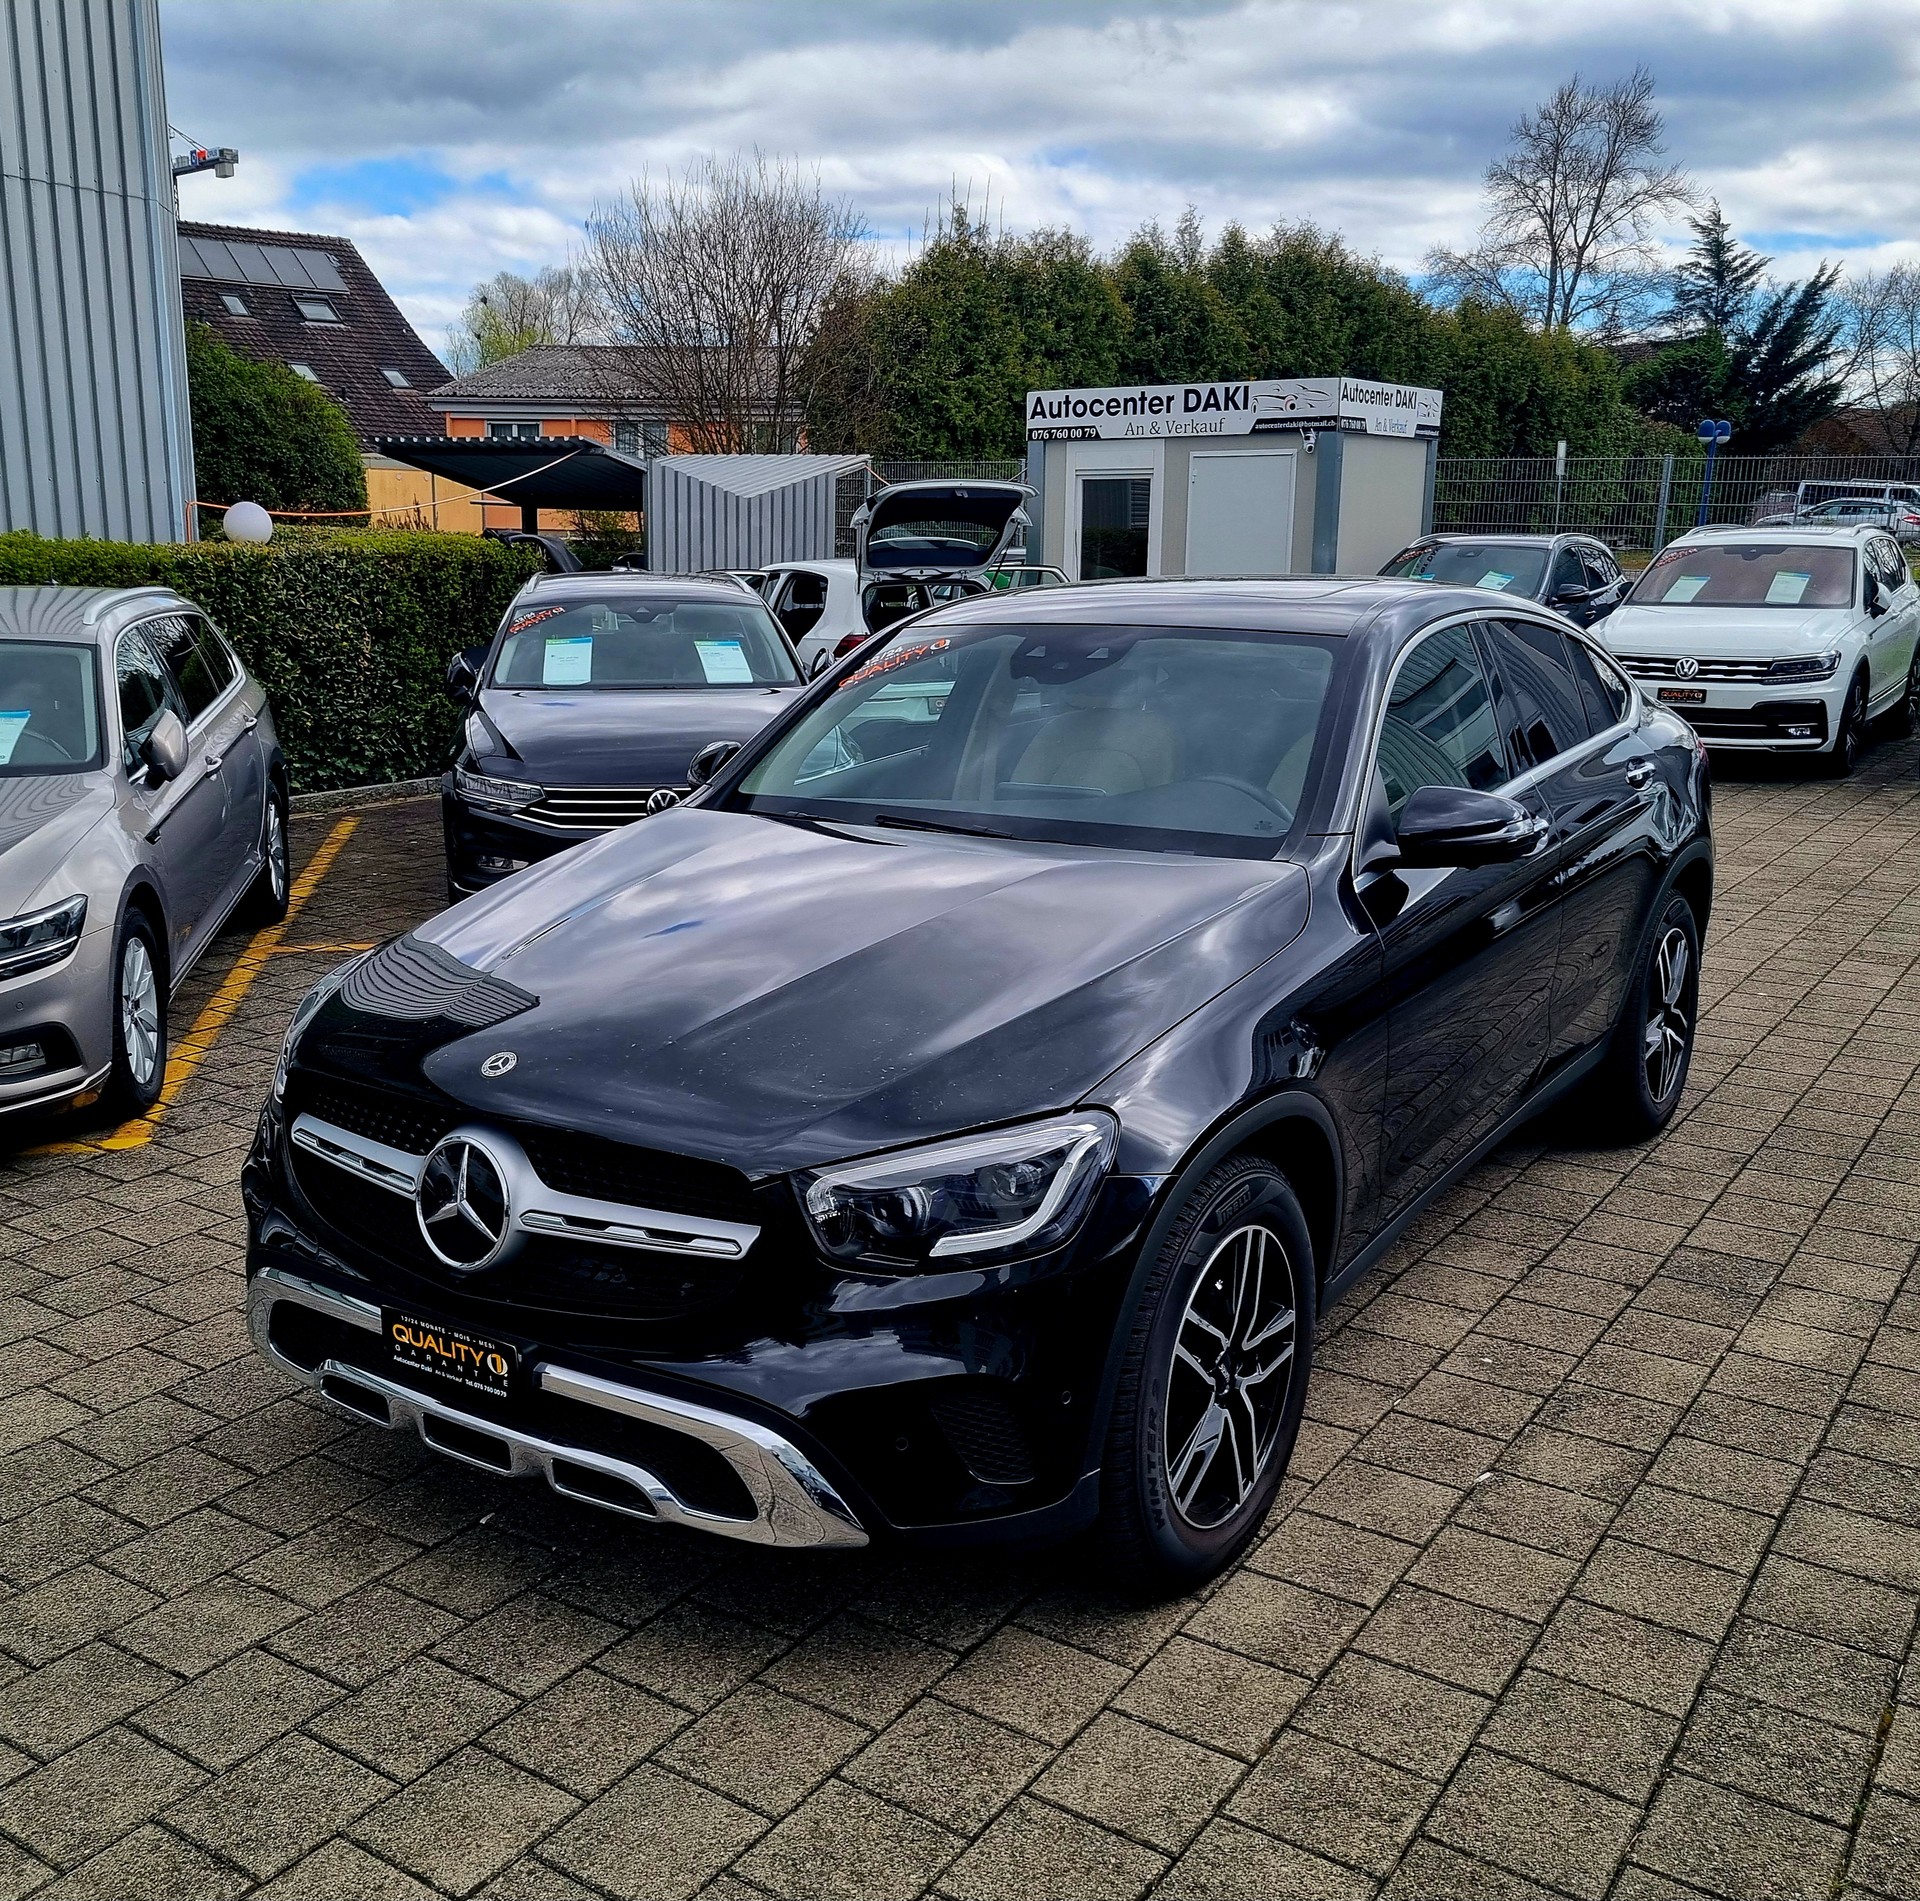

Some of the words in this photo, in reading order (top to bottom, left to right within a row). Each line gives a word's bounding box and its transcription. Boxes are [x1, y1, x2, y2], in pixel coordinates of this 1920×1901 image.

[1029, 390, 1175, 420] Autocenter
[1182, 385, 1250, 413] DAKI
[1341, 382, 1394, 407] Autocenter
[1395, 389, 1418, 410] DAKI
[1031, 428, 1050, 440] 076
[1051, 427, 1069, 439] 760
[1070, 427, 1082, 439] 00
[1084, 427, 1096, 438] 79
[1124, 421, 1145, 436] An
[1149, 420, 1161, 434] &
[1165, 417, 1226, 434] Verkauf
[838, 645, 929, 687] QUALITY
[1214, 1183, 1253, 1228] PIRELLI
[392, 1323, 485, 1367] QUALITY
